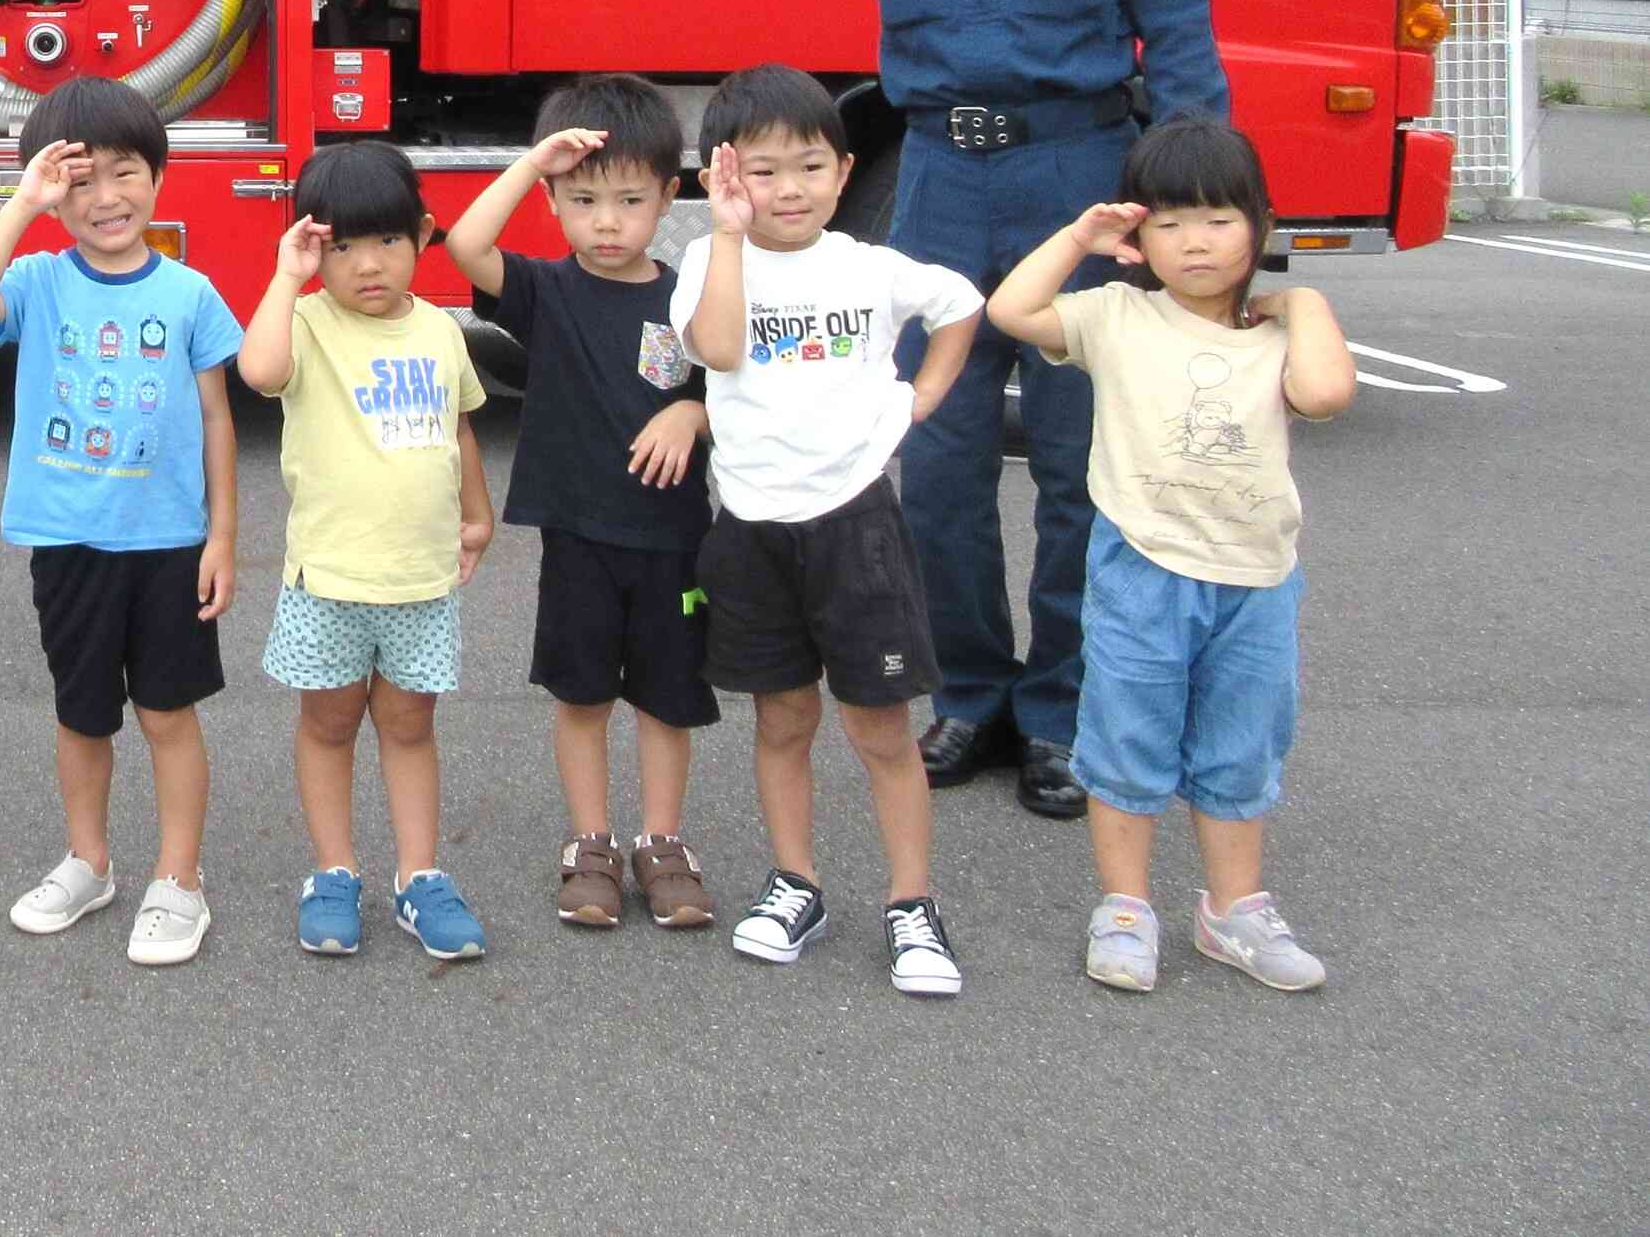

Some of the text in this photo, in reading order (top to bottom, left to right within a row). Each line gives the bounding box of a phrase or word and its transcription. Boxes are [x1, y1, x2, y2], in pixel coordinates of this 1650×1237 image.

[750, 302, 817, 317] Disney PIXAR
[826, 308, 874, 340] OUT
[370, 357, 437, 390] STAY
